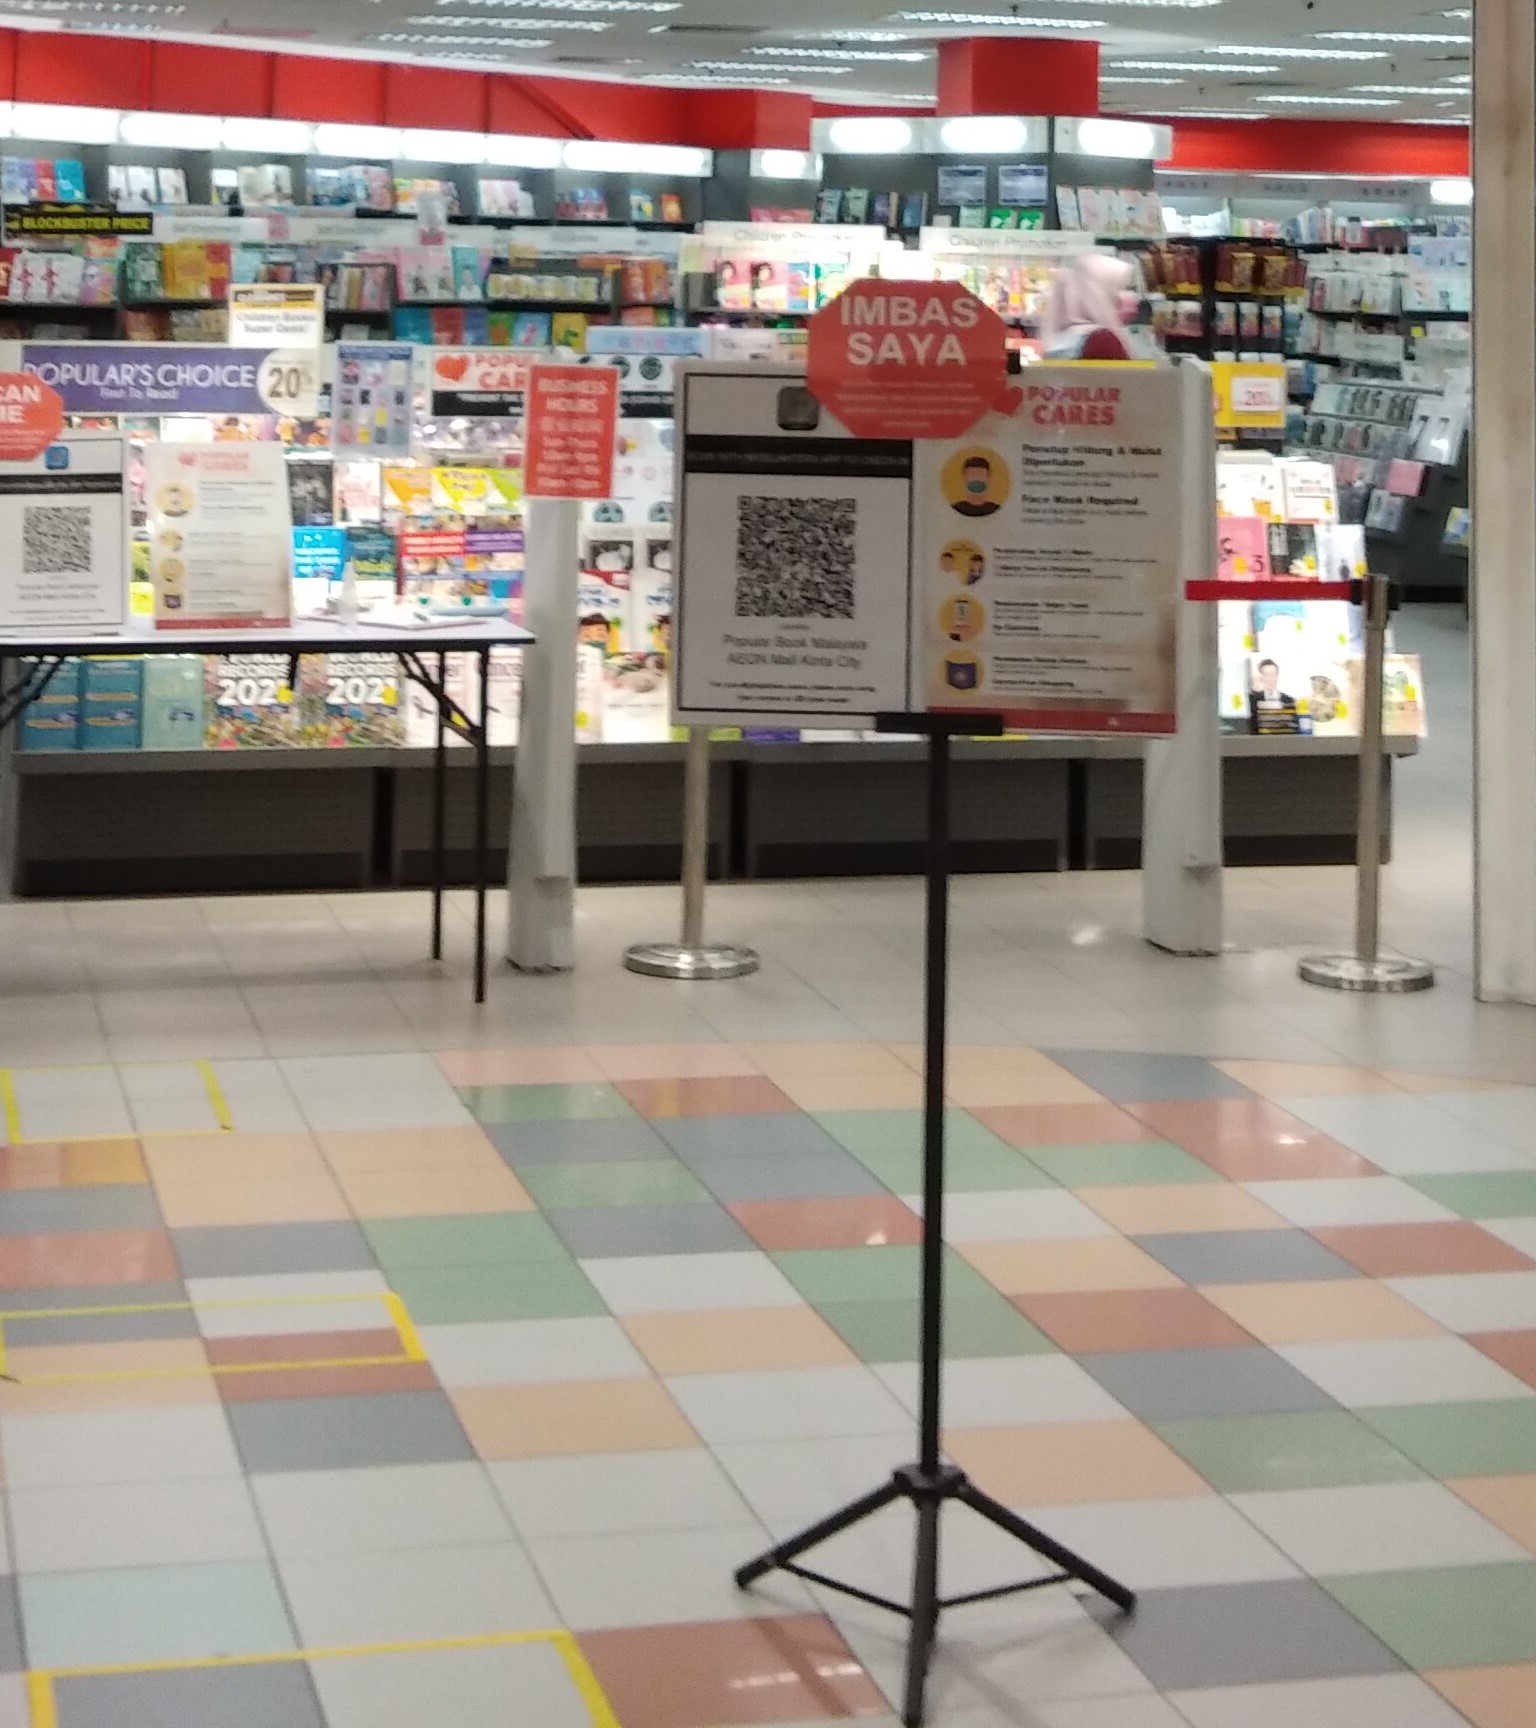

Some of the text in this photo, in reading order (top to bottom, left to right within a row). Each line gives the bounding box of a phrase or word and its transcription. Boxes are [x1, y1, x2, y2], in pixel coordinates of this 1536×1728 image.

[22, 216, 151, 231] BLOCKBUSTER PRICE
[839, 294, 981, 329] IMBAS
[845, 330, 969, 367] SAYA
[473, 352, 534, 368] POPU
[156, 363, 256, 389] CHOICE
[478, 371, 527, 389] CAR
[1028, 384, 1122, 403] POPULAR
[1030, 404, 1116, 426] CARES
[216, 678, 293, 706] 202
